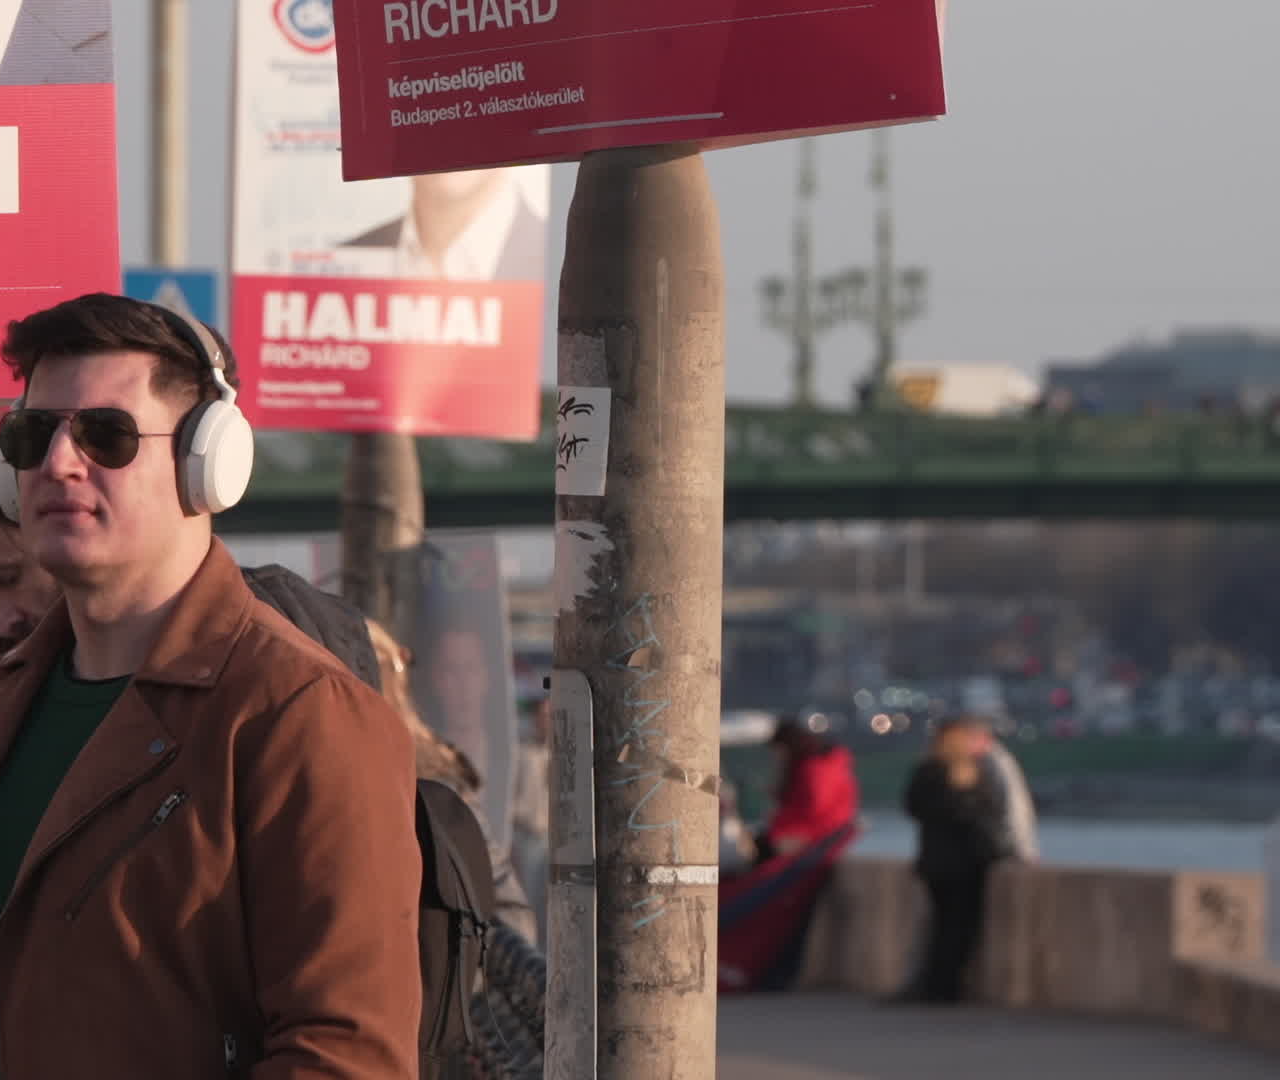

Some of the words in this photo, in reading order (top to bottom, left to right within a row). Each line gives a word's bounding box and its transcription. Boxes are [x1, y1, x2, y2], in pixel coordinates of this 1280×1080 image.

[387, 60, 526, 100] képviselőjelölt
[390, 102, 461, 127] Budapest
[463, 100, 478, 118] 2.
[478, 85, 585, 117] választókerület
[262, 291, 503, 346] HALMAI
